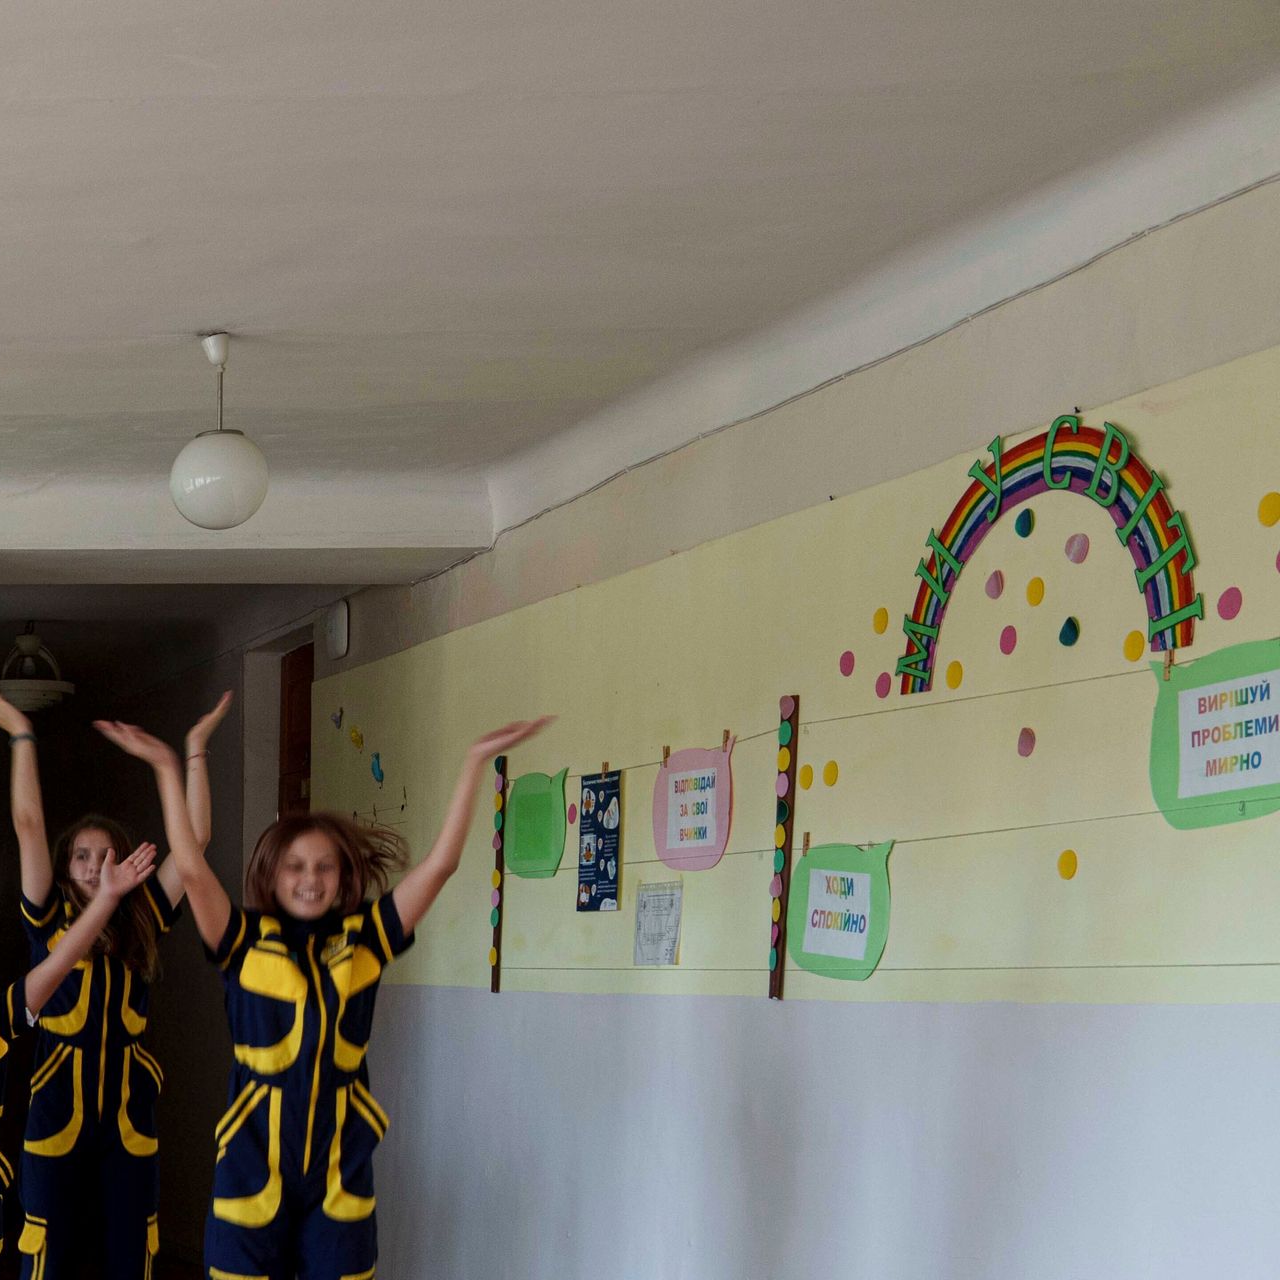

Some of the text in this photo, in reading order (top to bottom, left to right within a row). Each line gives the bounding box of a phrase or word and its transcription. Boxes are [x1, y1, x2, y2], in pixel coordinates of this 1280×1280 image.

[895, 527, 965, 685] МИ
[1042, 415, 1204, 643] СВІТІ
[1197, 680, 1271, 715] ВИРІШУЙ
[1191, 714, 1279, 748] ПРОБЛЕМИ
[1205, 751, 1262, 777] МИРНО
[674, 772, 716, 795] ВІДПОВІДАЙ
[680, 798, 708, 817] ЗА СВОЇ
[680, 826, 708, 842] ВЧИНКИ
[825, 875, 854, 900] ХОДИ
[811, 909, 867, 934] СПОКІЙНО
